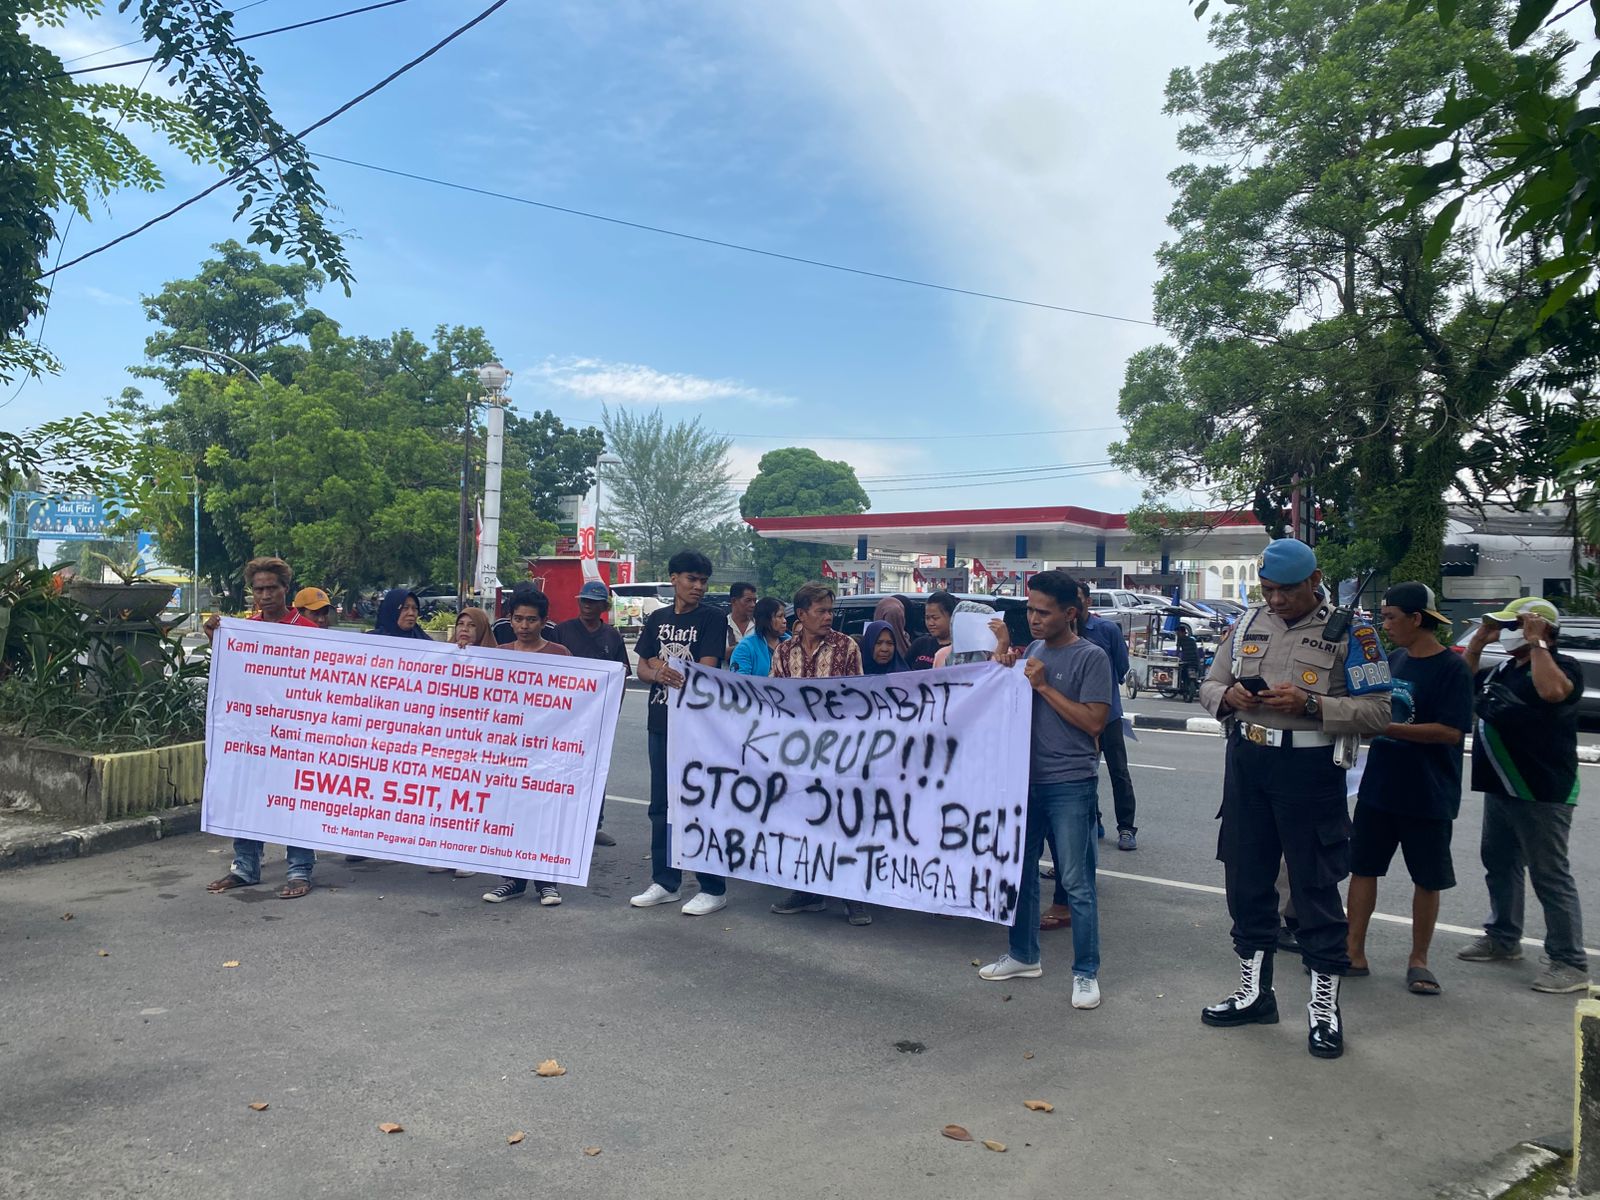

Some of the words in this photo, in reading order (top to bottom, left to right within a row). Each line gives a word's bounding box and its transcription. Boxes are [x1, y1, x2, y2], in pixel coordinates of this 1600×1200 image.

[57, 503, 73, 514] Idul
[76, 503, 95, 514] Fitri
[657, 624, 698, 642] Black
[1301, 637, 1337, 654] POLRI
[227, 636, 259, 653] Kami
[262, 643, 310, 660] mantan
[313, 647, 367, 669] pegawai
[370, 654, 394, 669] dan
[397, 657, 448, 675] honorer
[451, 662, 504, 682] DISHUB
[507, 669, 543, 686] KOTA
[547, 673, 597, 692] MEDAN
[244, 662, 306, 679] menuntut
[309, 666, 367, 687] MANTAN
[370, 673, 422, 693] KEPALA
[426, 681, 479, 700] DISHUB
[483, 687, 518, 704] KOTA
[523, 691, 572, 710] MEDAN
[285, 687, 322, 702] untuk
[326, 690, 400, 711] kembalikan
[403, 701, 435, 719] uang
[438, 703, 490, 722] insentif
[492, 710, 524, 726] kami
[677, 663, 795, 718] ISWAR
[800, 682, 973, 725] PEJABAT
[225, 700, 252, 717] yang
[255, 703, 327, 725] seharusnya
[331, 711, 362, 728] kami
[365, 718, 441, 737] pergunakan
[445, 726, 483, 742] untuk
[486, 731, 517, 746] anak
[521, 733, 548, 750] istri
[551, 737, 585, 757] kami,
[270, 724, 302, 742] Kami
[304, 731, 367, 749] memohon
[371, 737, 419, 757] kepada
[421, 743, 479, 764] Penegak
[481, 750, 529, 768] Hukum
[223, 740, 266, 756] periksa
[269, 745, 314, 763] Mantan
[318, 750, 388, 772] KADISHUB
[392, 760, 427, 777] KOTA
[431, 764, 481, 783] MEDAN
[484, 772, 517, 788] yaitu
[521, 775, 574, 795] Saudara
[293, 768, 374, 800] ISWAR.
[381, 780, 442, 812] S.SIT,
[450, 788, 491, 814] M.T
[680, 761, 787, 823] STOP
[266, 793, 296, 811] yang
[299, 798, 391, 821] menggelapkan
[394, 809, 425, 825] dana
[429, 812, 480, 832] insentif
[482, 819, 514, 837] kami
[321, 824, 338, 834] Ttd:
[340, 826, 374, 839] Mantan
[376, 831, 416, 845] Pegawai
[418, 837, 438, 848] Dan
[439, 839, 477, 853] Honorer
[479, 845, 512, 857] Dishub
[514, 849, 537, 861] Kota
[539, 852, 571, 865] Medan
